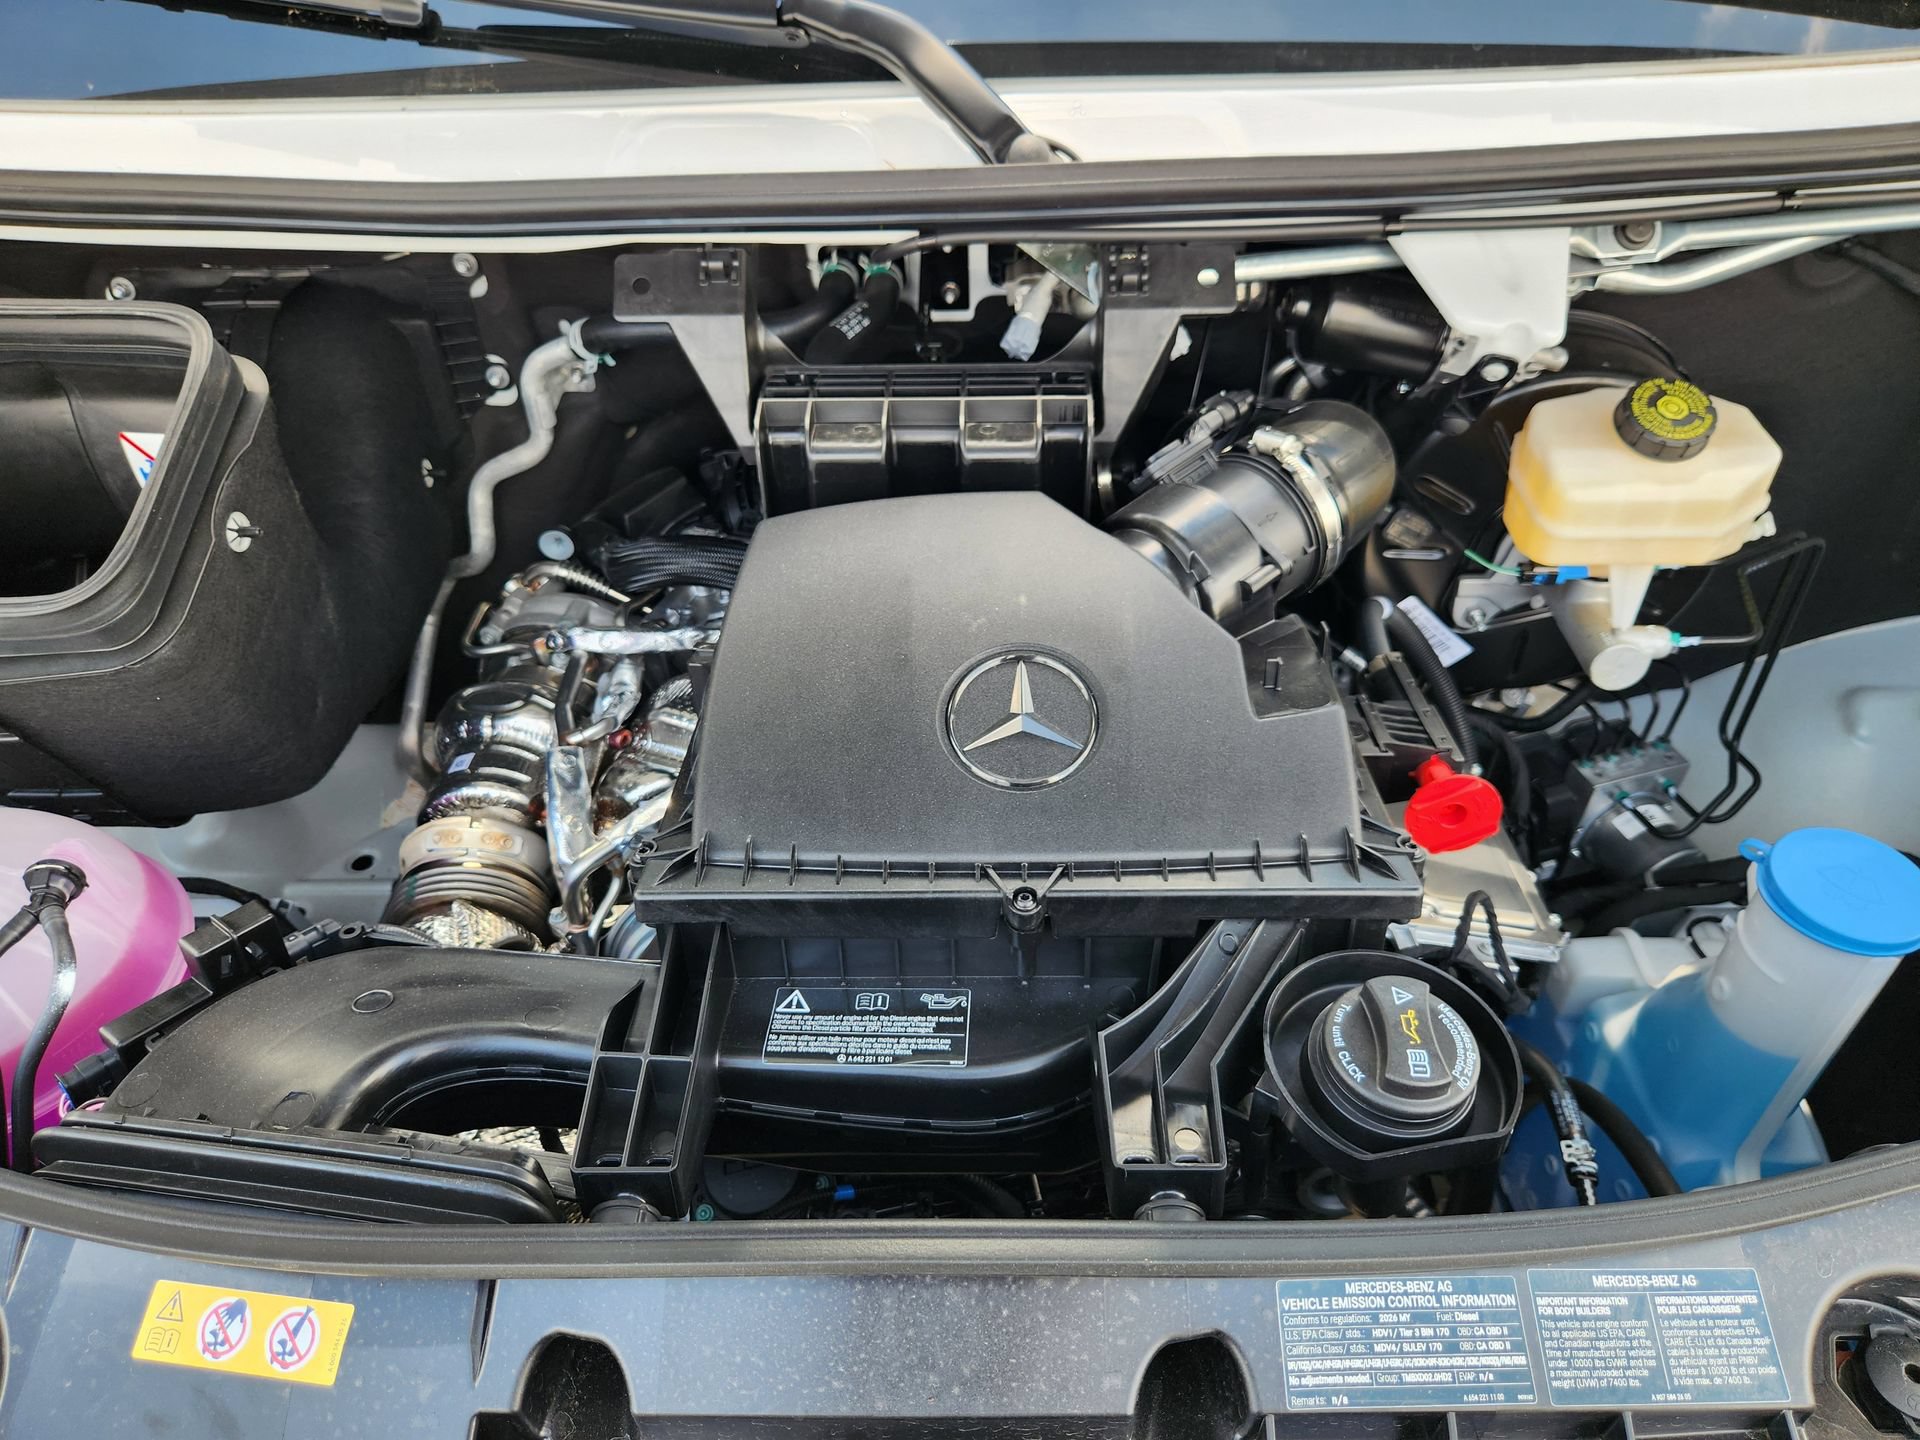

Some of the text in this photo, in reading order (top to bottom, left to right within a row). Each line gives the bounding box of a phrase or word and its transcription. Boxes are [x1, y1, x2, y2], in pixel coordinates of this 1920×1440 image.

[1332, 1003, 1366, 1083] Turn until CLICK
[1438, 1013, 1466, 1077] recommended
[1438, 1003, 1477, 1091] Mercedes-Benz Oil
[1592, 1275, 1697, 1287] MERCEDES-BENZ AG
[1345, 1280, 1452, 1294] MERCEDES-BENZ AG
[1282, 1294, 1516, 1310] VEHICLE EMISSION CONTROL INFORMATION
[1536, 1296, 1628, 1306] IMPORTANT INFORMATION
[1655, 1295, 1757, 1304] INFORMATIONS IMPORTANTES
[1538, 1306, 1611, 1315] FOR BODY BUILDERS
[1657, 1305, 1741, 1314] POUR LES CARROSSIERS
[1283, 1313, 1410, 1326] Conforms to regulations: 2026 MY
[1436, 1312, 1479, 1320] Fuel: Diesel
[1540, 1319, 1648, 1329] This vehicle and engine conform
[1285, 1330, 1300, 1340] U.S.
[1303, 1330, 1318, 1339] EPA
[1319, 1329, 1343, 1341] Class/
[1346, 1329, 1366, 1338] stds.:
[1399, 1328, 1412, 1337] Tier
[1415, 1327, 1419, 1336] 3
[1421, 1327, 1434, 1336] BIN
[1436, 1327, 1449, 1336] 170
[1457, 1326, 1474, 1336] OBD:
[1474, 1326, 1484, 1335] CA
[1486, 1326, 1502, 1335] OBD
[1562, 1330, 1596, 1339] applicable
[1626, 1329, 1646, 1337] CARB
[1286, 1342, 1442, 1356] California Class/ stds.: MDV4/ SULEV 170
[1460, 1342, 1476, 1350] OBD:
[1477, 1342, 1487, 1350] CA
[1489, 1341, 1504, 1350] OBD
[1593, 1339, 1630, 1349] regulations
[1572, 1349, 1615, 1357] manufacture
[1617, 1349, 1626, 1357] for
[1548, 1359, 1568, 1367] under
[1571, 1359, 1593, 1367] 10000
[1644, 1358, 1656, 1366] has
[1459, 1372, 1494, 1382] EVAP: n/a
[1556, 1369, 1590, 1377] maximum
[1624, 1368, 1648, 1376] vehicle
[1289, 1373, 1372, 1387] No adjustments needed.
[1377, 1373, 1400, 1384] Group:
[1552, 1379, 1575, 1388] weight
[1609, 1378, 1627, 1386] 7400
[1629, 1378, 1642, 1386] lbs.
[1291, 1395, 1348, 1406] Remarks: n/a
